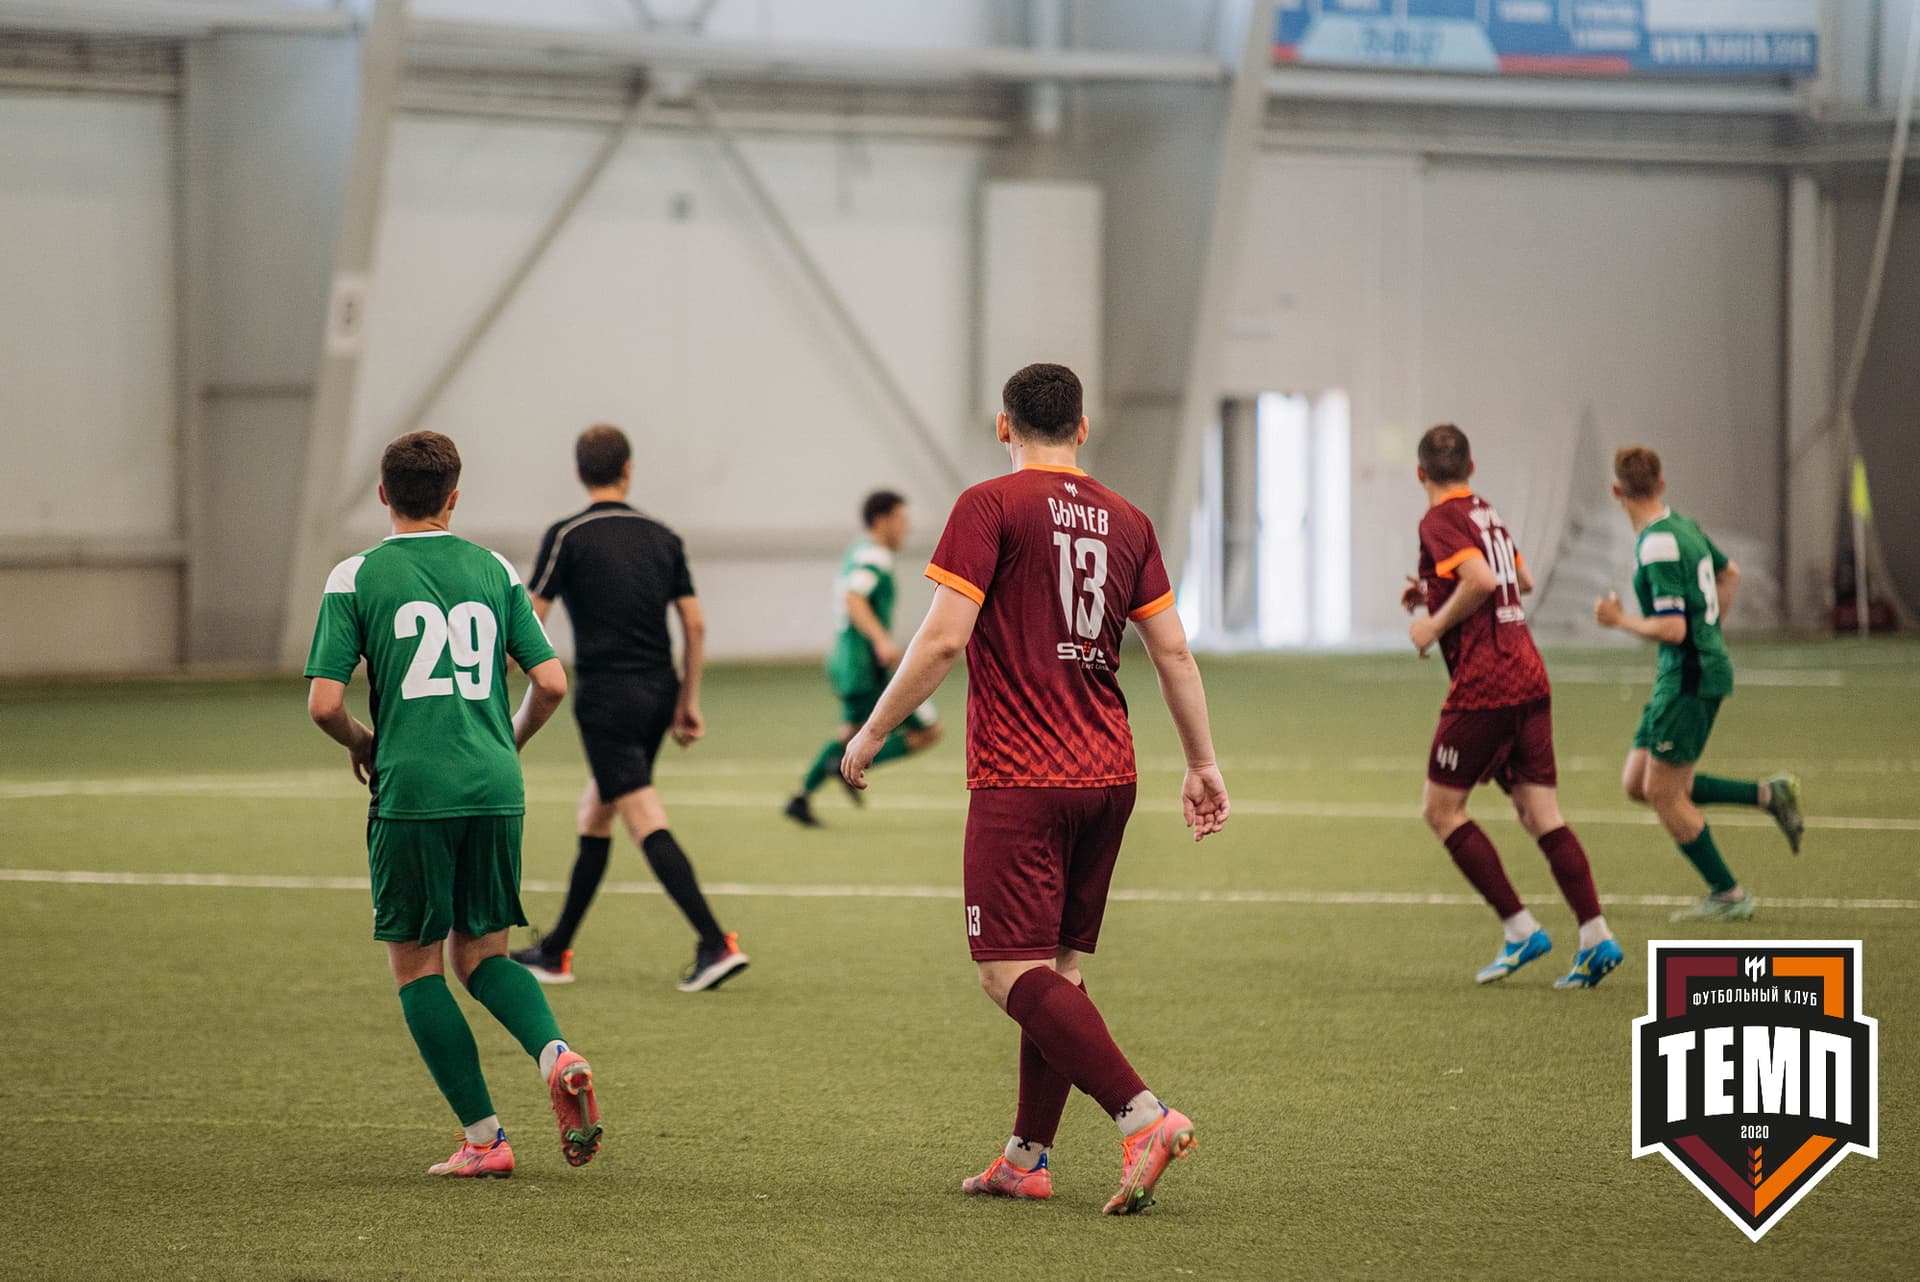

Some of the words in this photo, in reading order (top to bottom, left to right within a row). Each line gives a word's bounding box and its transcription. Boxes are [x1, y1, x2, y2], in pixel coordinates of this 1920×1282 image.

[1047, 497, 1109, 536] СЫЧЕВ
[1053, 531, 1108, 640] 13
[393, 600, 498, 701] 29
[1436, 743, 1459, 773] 44
[966, 904, 981, 937] 13
